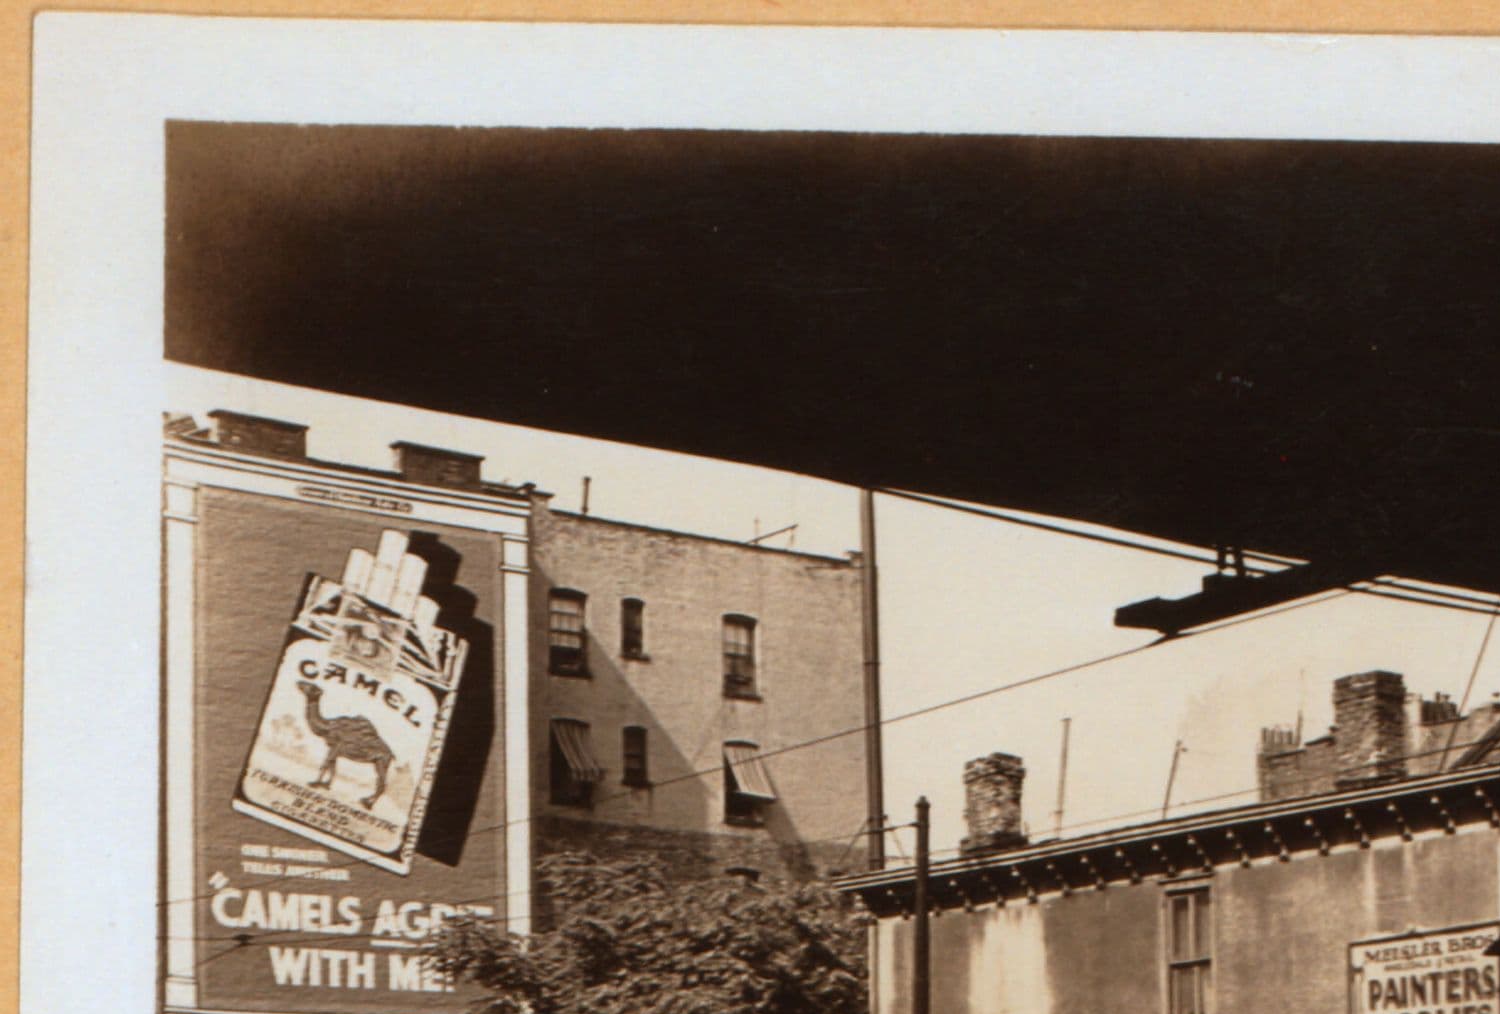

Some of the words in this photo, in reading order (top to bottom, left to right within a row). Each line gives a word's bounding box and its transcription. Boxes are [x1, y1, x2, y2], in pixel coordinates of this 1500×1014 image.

[297, 658, 422, 728] CAMEL
[269, 946, 376, 989] WITH
[1367, 964, 1497, 1012] PAINTERS
